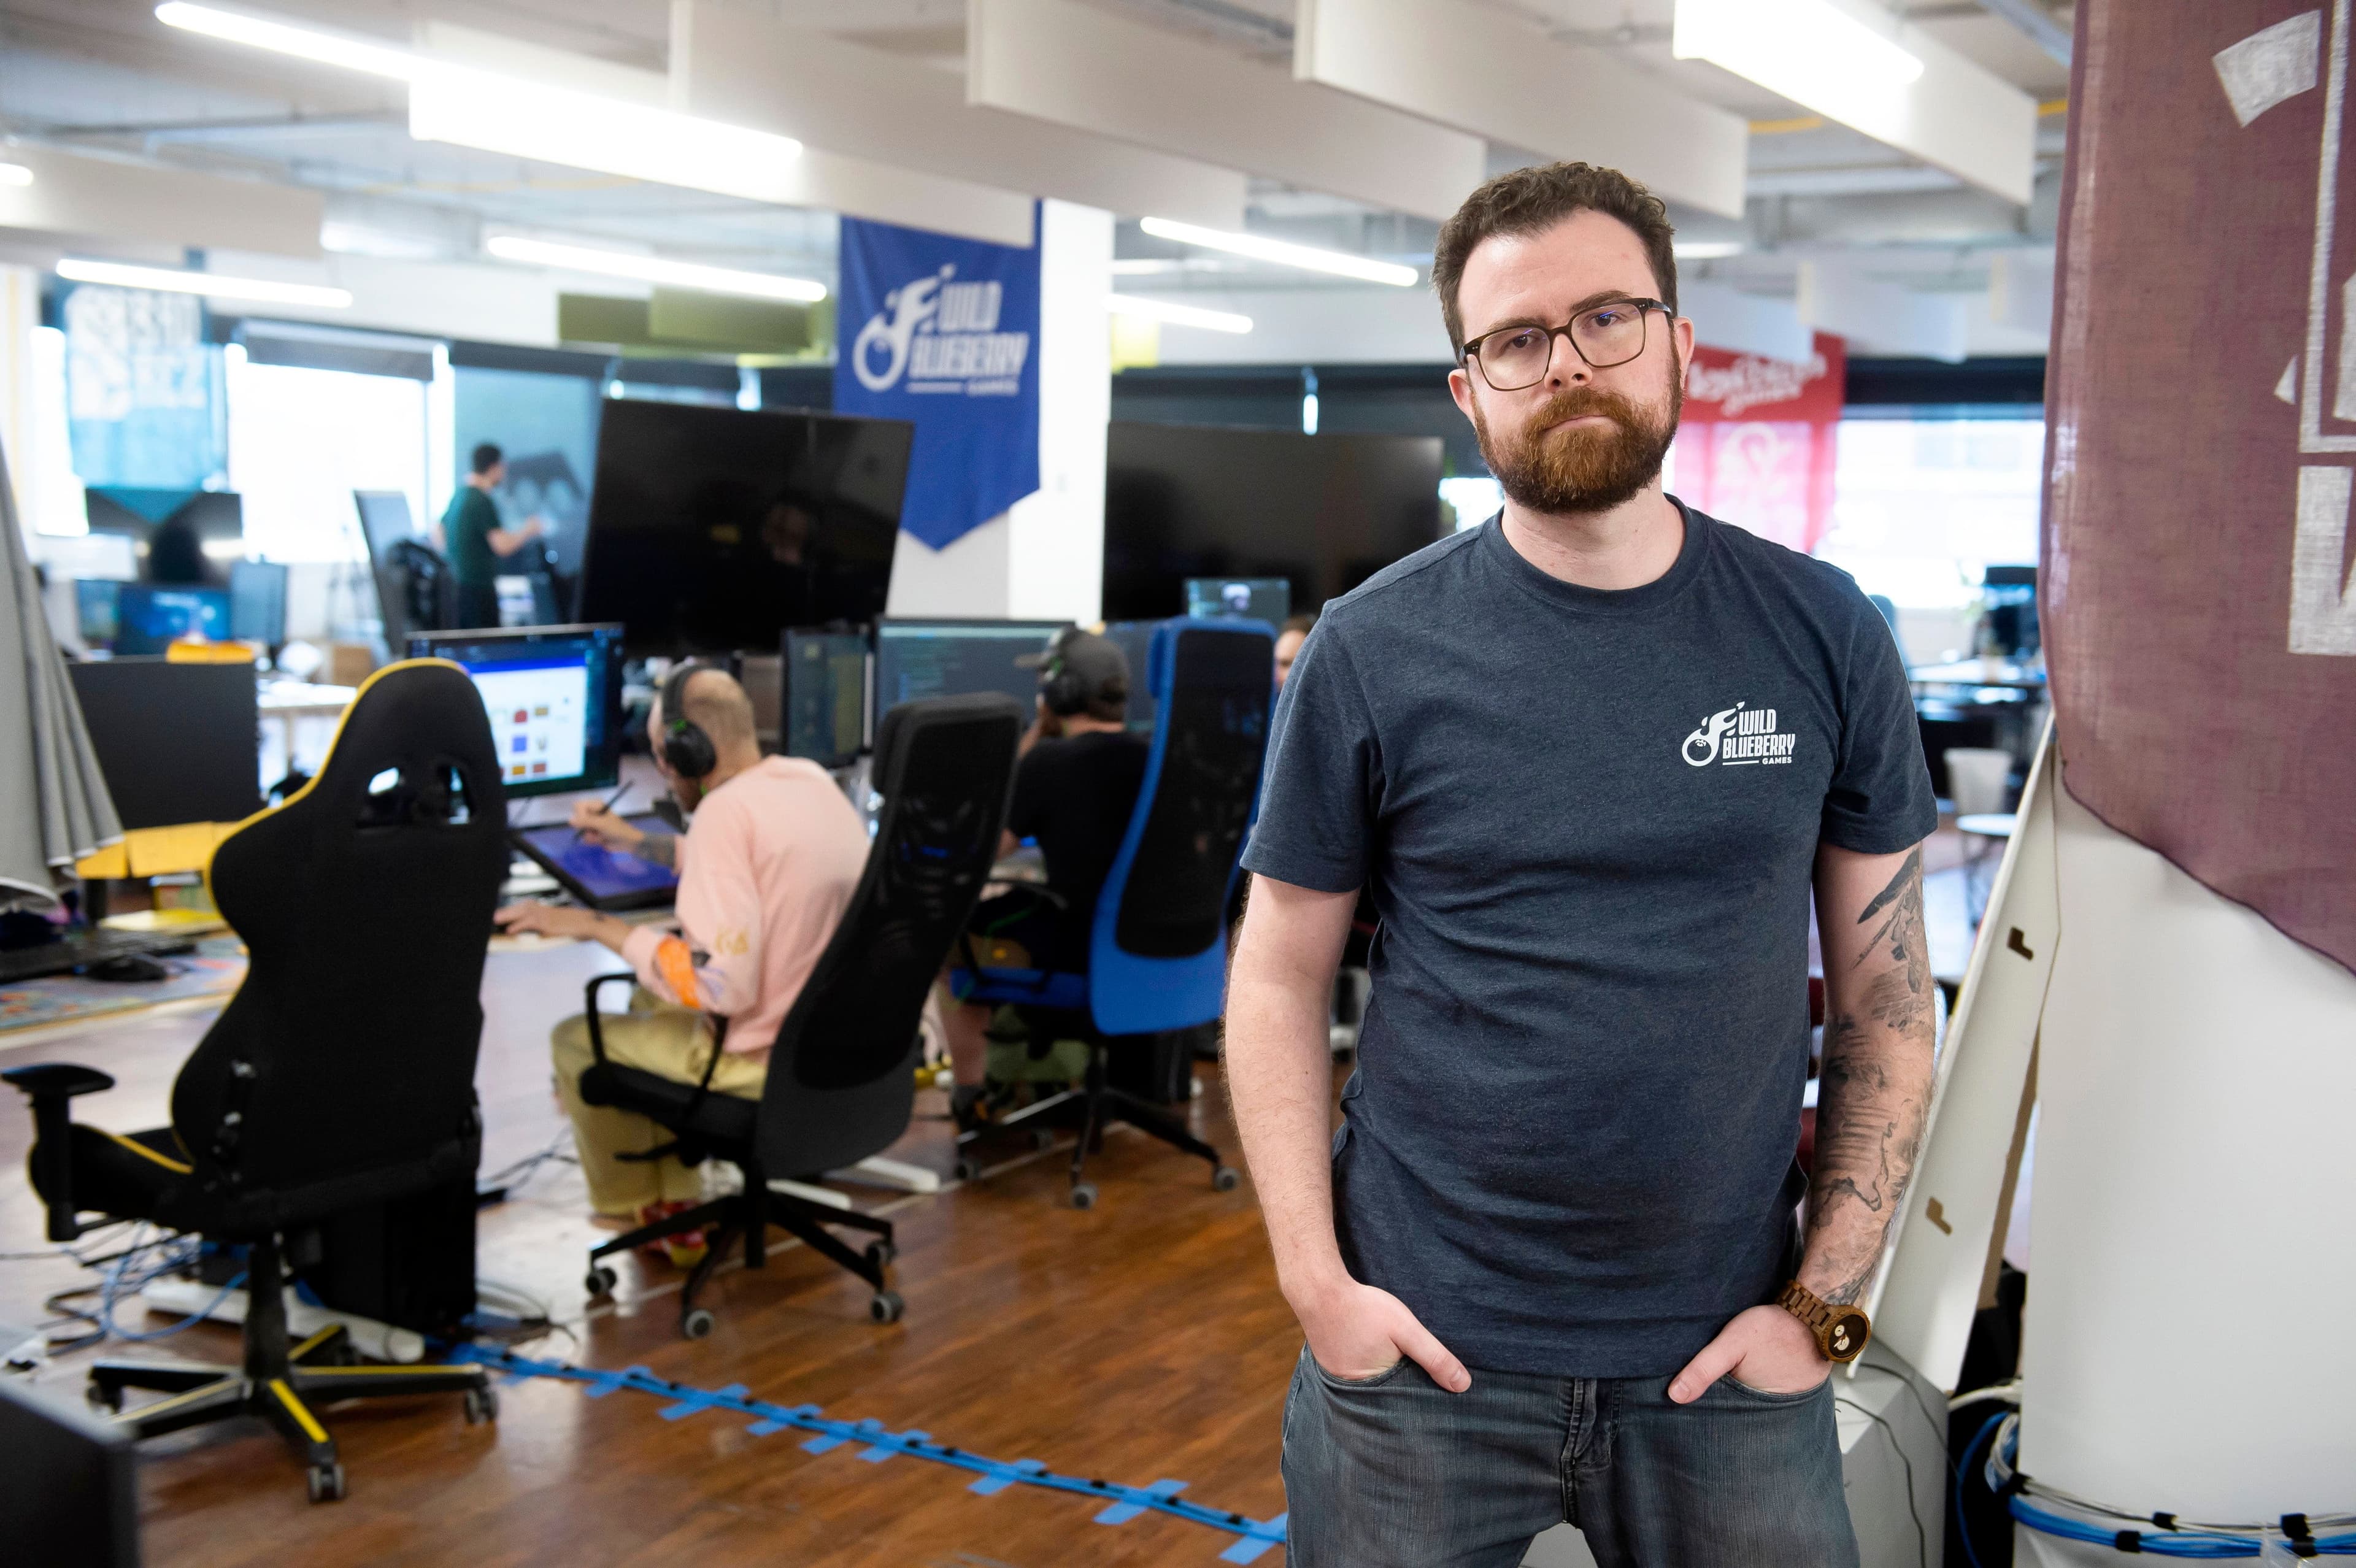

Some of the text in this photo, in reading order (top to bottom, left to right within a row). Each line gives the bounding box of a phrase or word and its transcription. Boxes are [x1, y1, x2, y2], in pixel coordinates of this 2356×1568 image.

[1738, 709, 1777, 736] WILD
[1722, 733, 1796, 759] BLUEBERRY
[1761, 756, 1792, 765] GAMES
